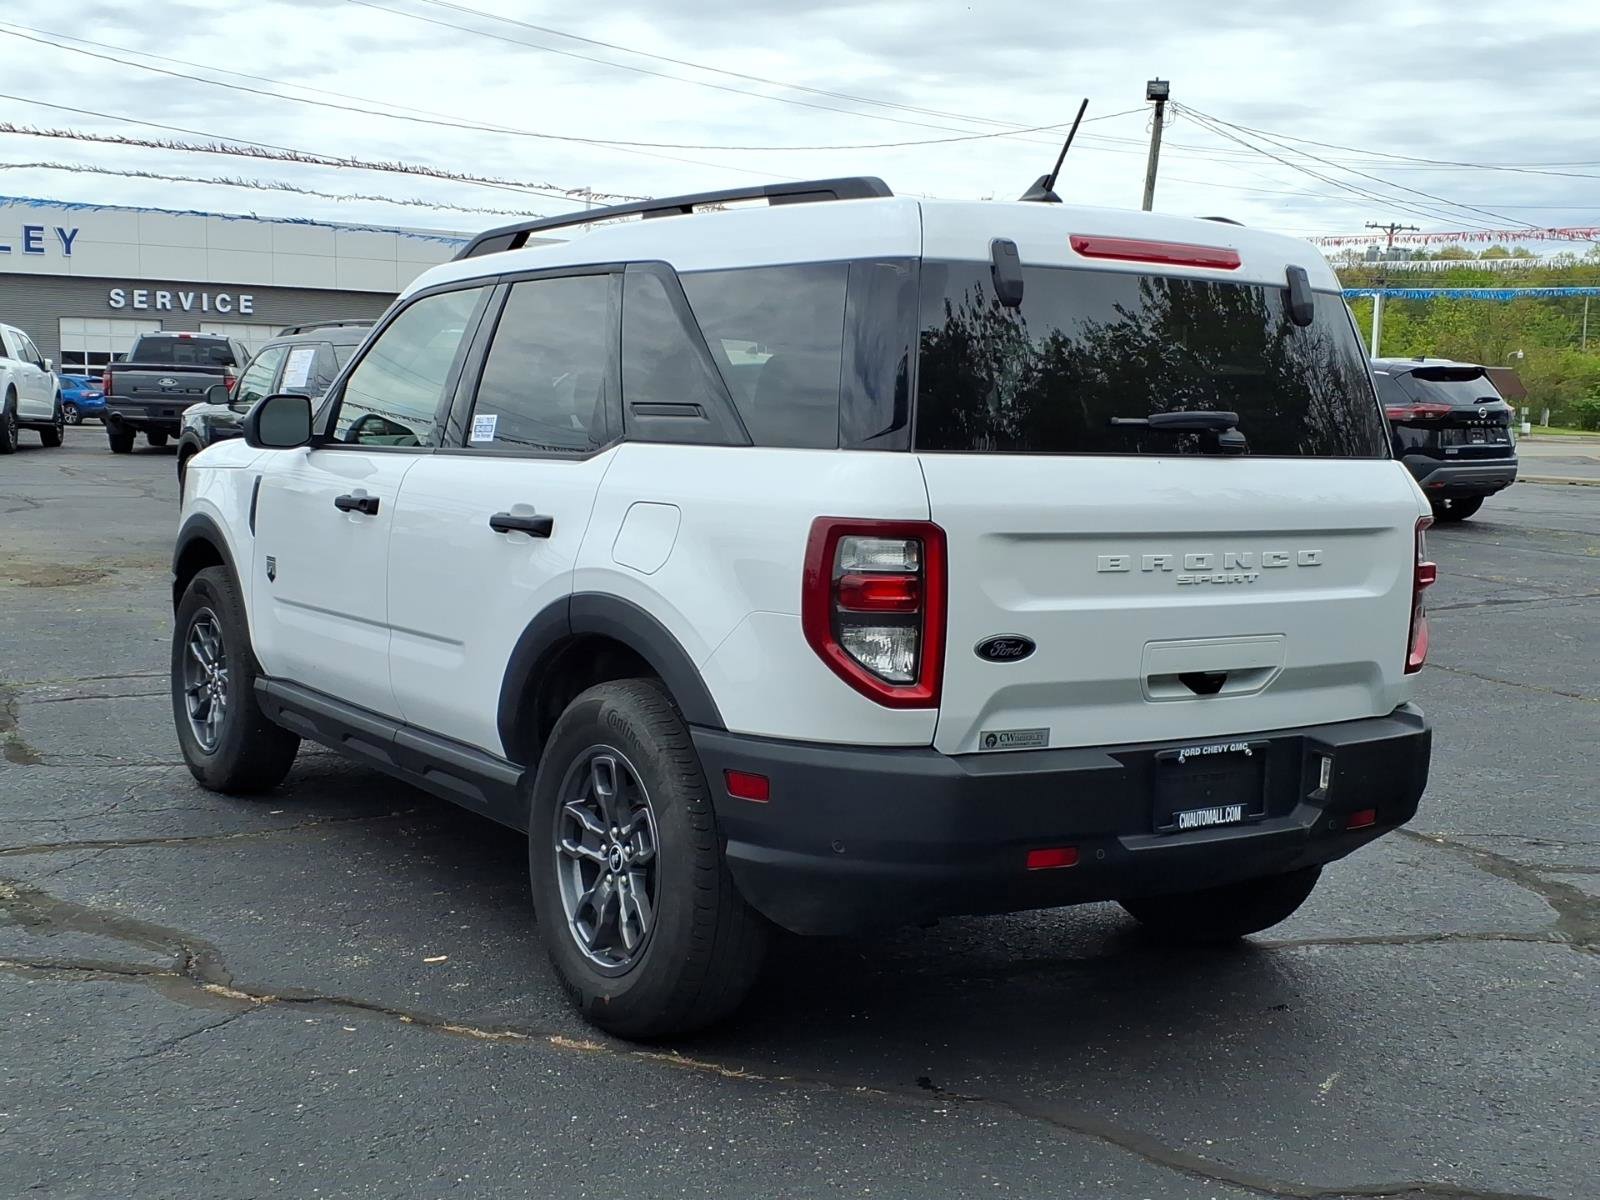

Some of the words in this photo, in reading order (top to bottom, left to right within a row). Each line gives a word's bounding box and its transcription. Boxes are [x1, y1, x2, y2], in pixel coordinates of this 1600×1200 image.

[109, 288, 254, 314] SERVICE
[1097, 550, 1322, 572] BRONCO
[1176, 572, 1259, 585] SPORT
[989, 640, 1024, 657] Ford
[1180, 747, 1201, 757] FORD
[1202, 744, 1229, 755] CHEVY
[1229, 742, 1249, 752] GMC
[1179, 805, 1241, 829] CWAUTOMALL.COM
